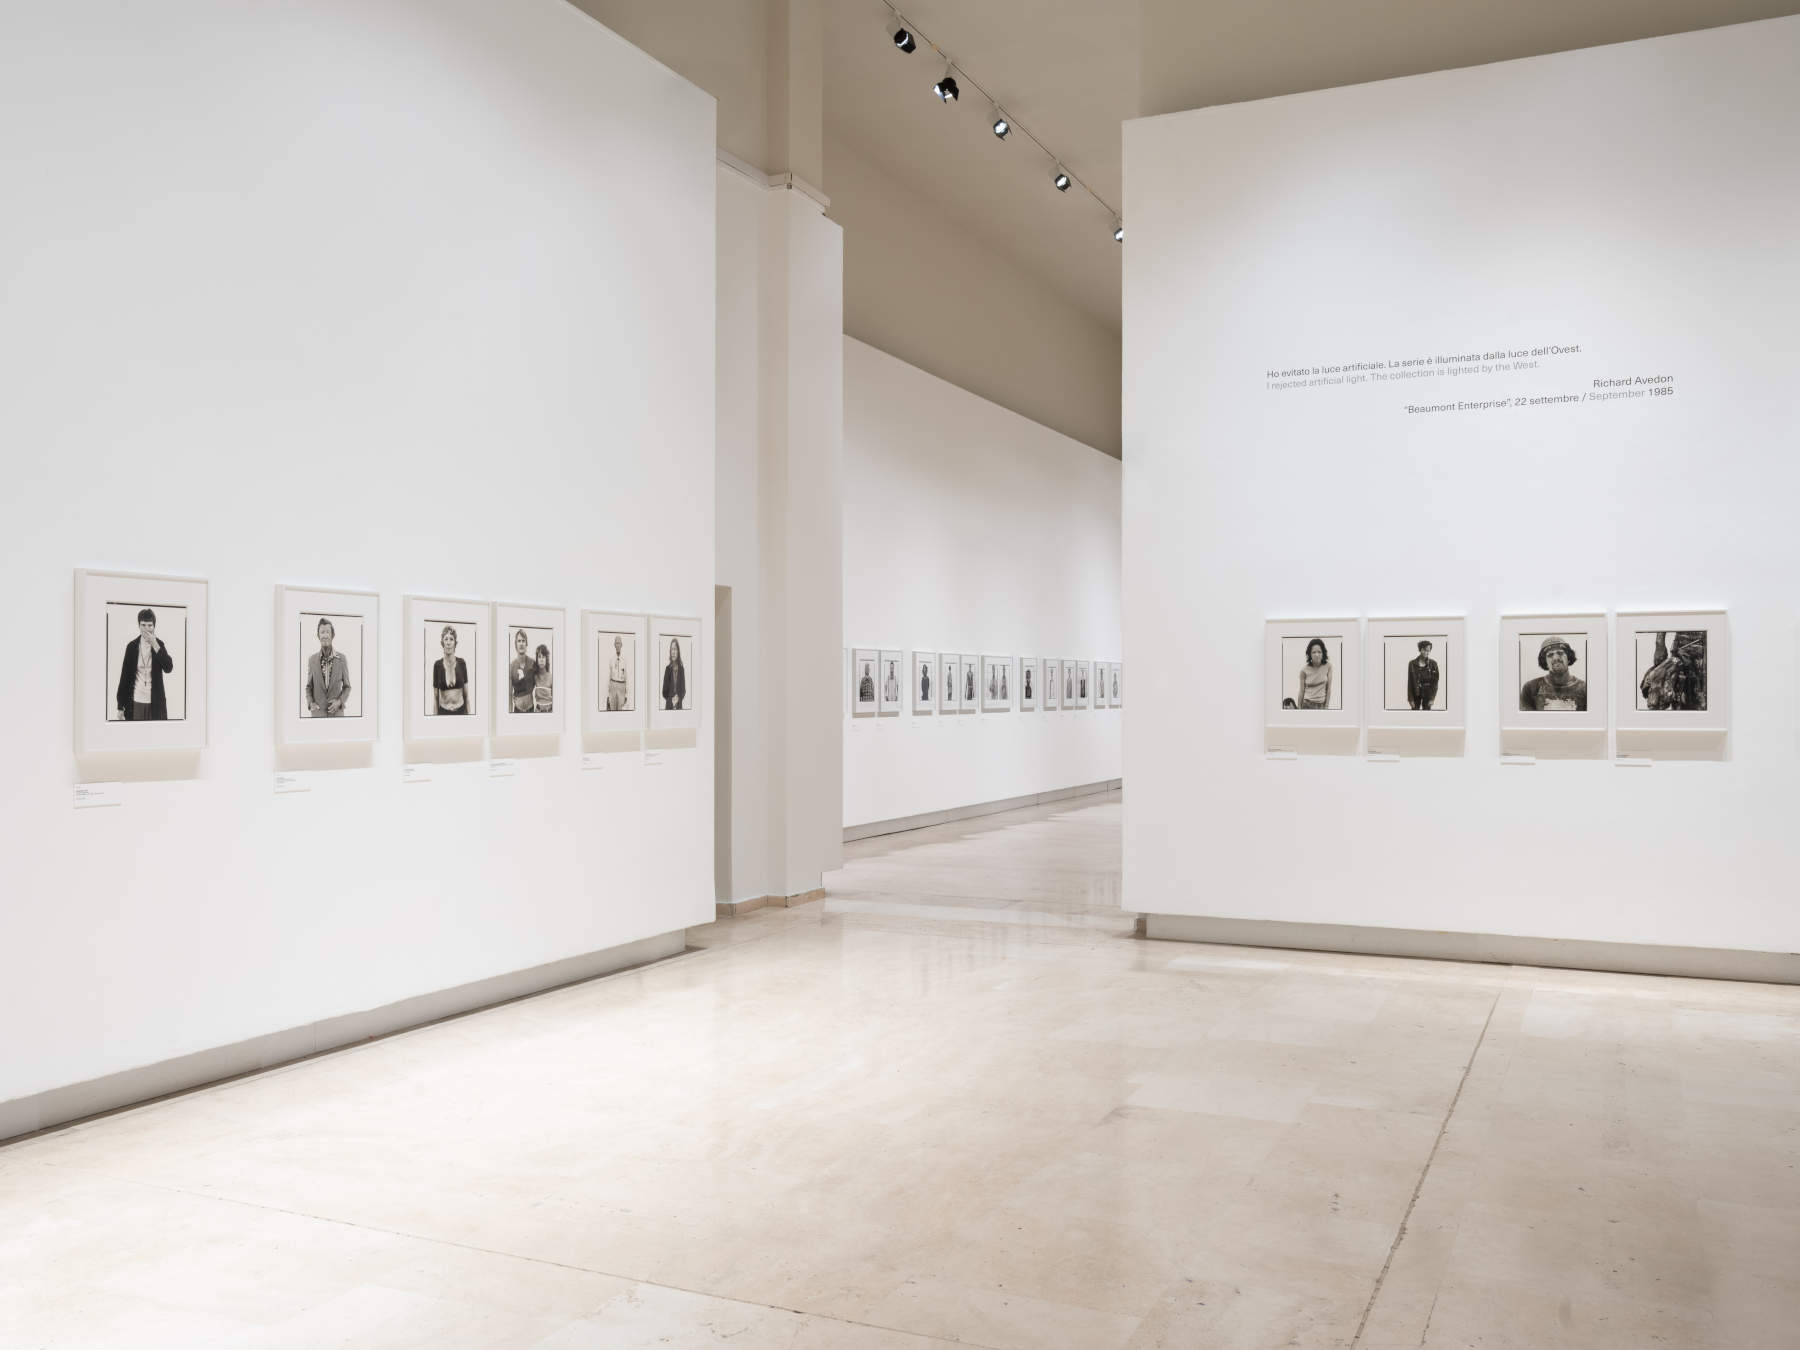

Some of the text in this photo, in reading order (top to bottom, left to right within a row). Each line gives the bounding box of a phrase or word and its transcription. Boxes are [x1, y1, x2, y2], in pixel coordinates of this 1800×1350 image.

[1266, 360, 1541, 391] I rejected artificial light. The collection is lighted by the West.
[1267, 370, 1279, 378] Ho
[1281, 368, 1310, 378] evitato
[1312, 367, 1320, 375] la
[1322, 366, 1341, 374] luce
[1342, 361, 1386, 373] artificiale.
[1388, 360, 1400, 368] La
[1401, 358, 1425, 368] serie
[1435, 354, 1481, 364] illuminata
[1483, 351, 1506, 361] dalla
[1508, 349, 1529, 358] luce
[1593, 375, 1674, 388] Richard Avedon
[1514, 397, 1527, 406] 22
[1529, 395, 1579, 404] settembre
[1582, 392, 1588, 402] /
[1589, 389, 1646, 402] September
[1648, 386, 1674, 396] 1985
